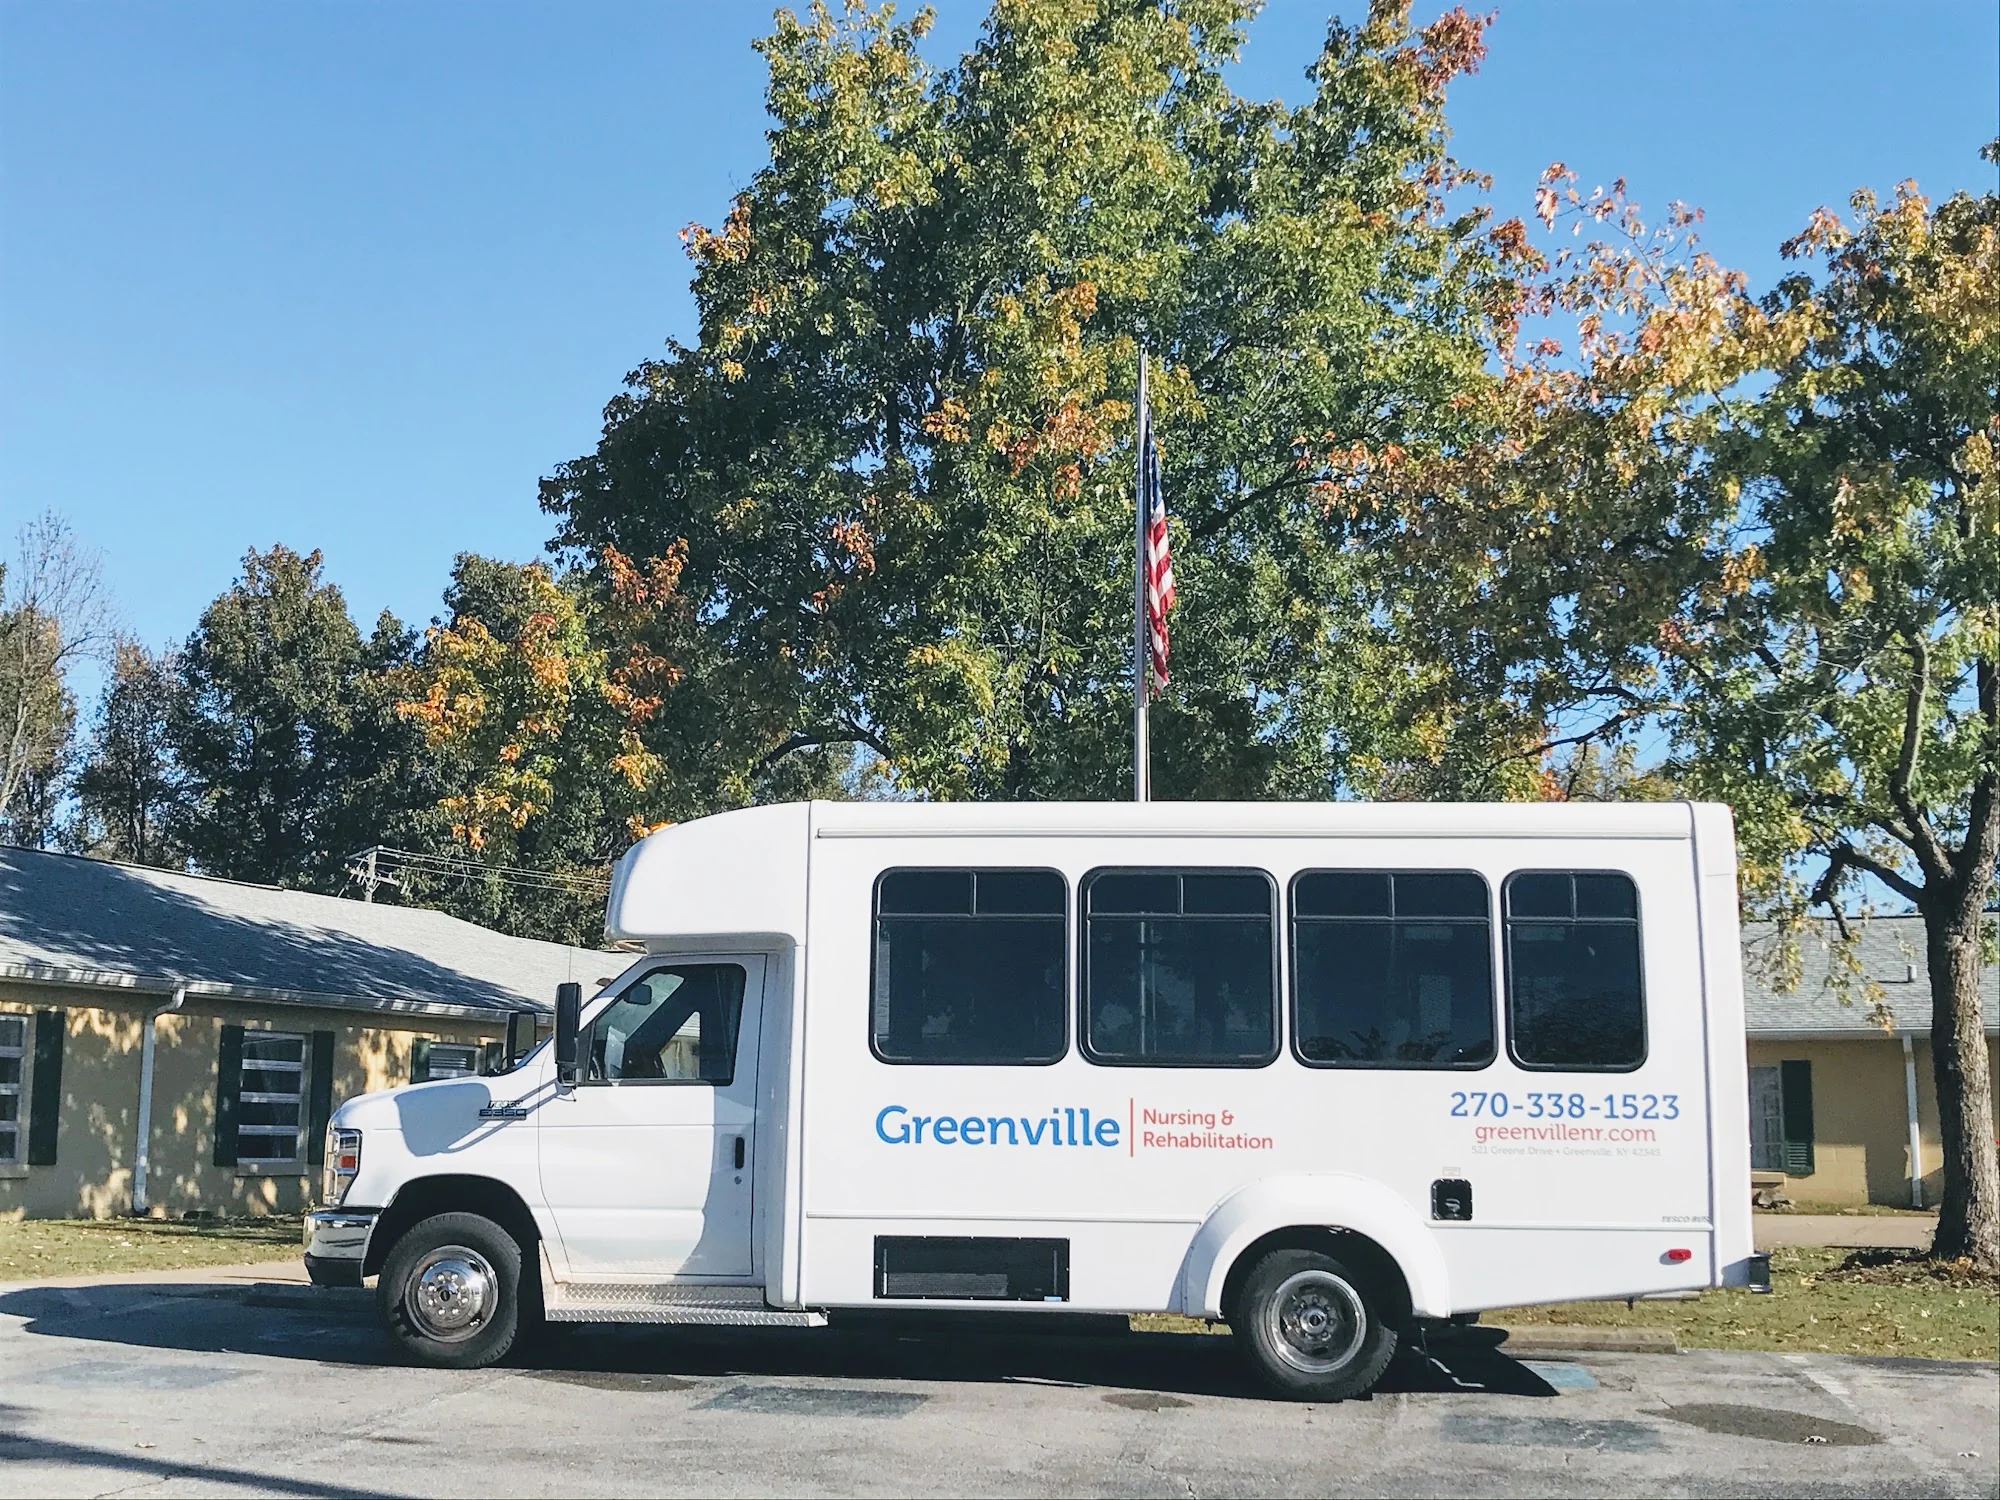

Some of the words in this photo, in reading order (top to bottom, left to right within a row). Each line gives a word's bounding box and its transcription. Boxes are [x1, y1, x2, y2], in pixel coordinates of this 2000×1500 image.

[1450, 1091, 1680, 1120] 270-338-1523
[875, 1104, 1120, 1146] Greenville
[1143, 1108, 1216, 1129] Nursing
[1220, 1109, 1234, 1125] &
[1143, 1131, 1273, 1149] Rehabilitation
[1474, 1123, 1656, 1144] greenvillenr.com
[1471, 1145, 1488, 1154] 521
[1528, 1146, 1553, 1155] Drive
